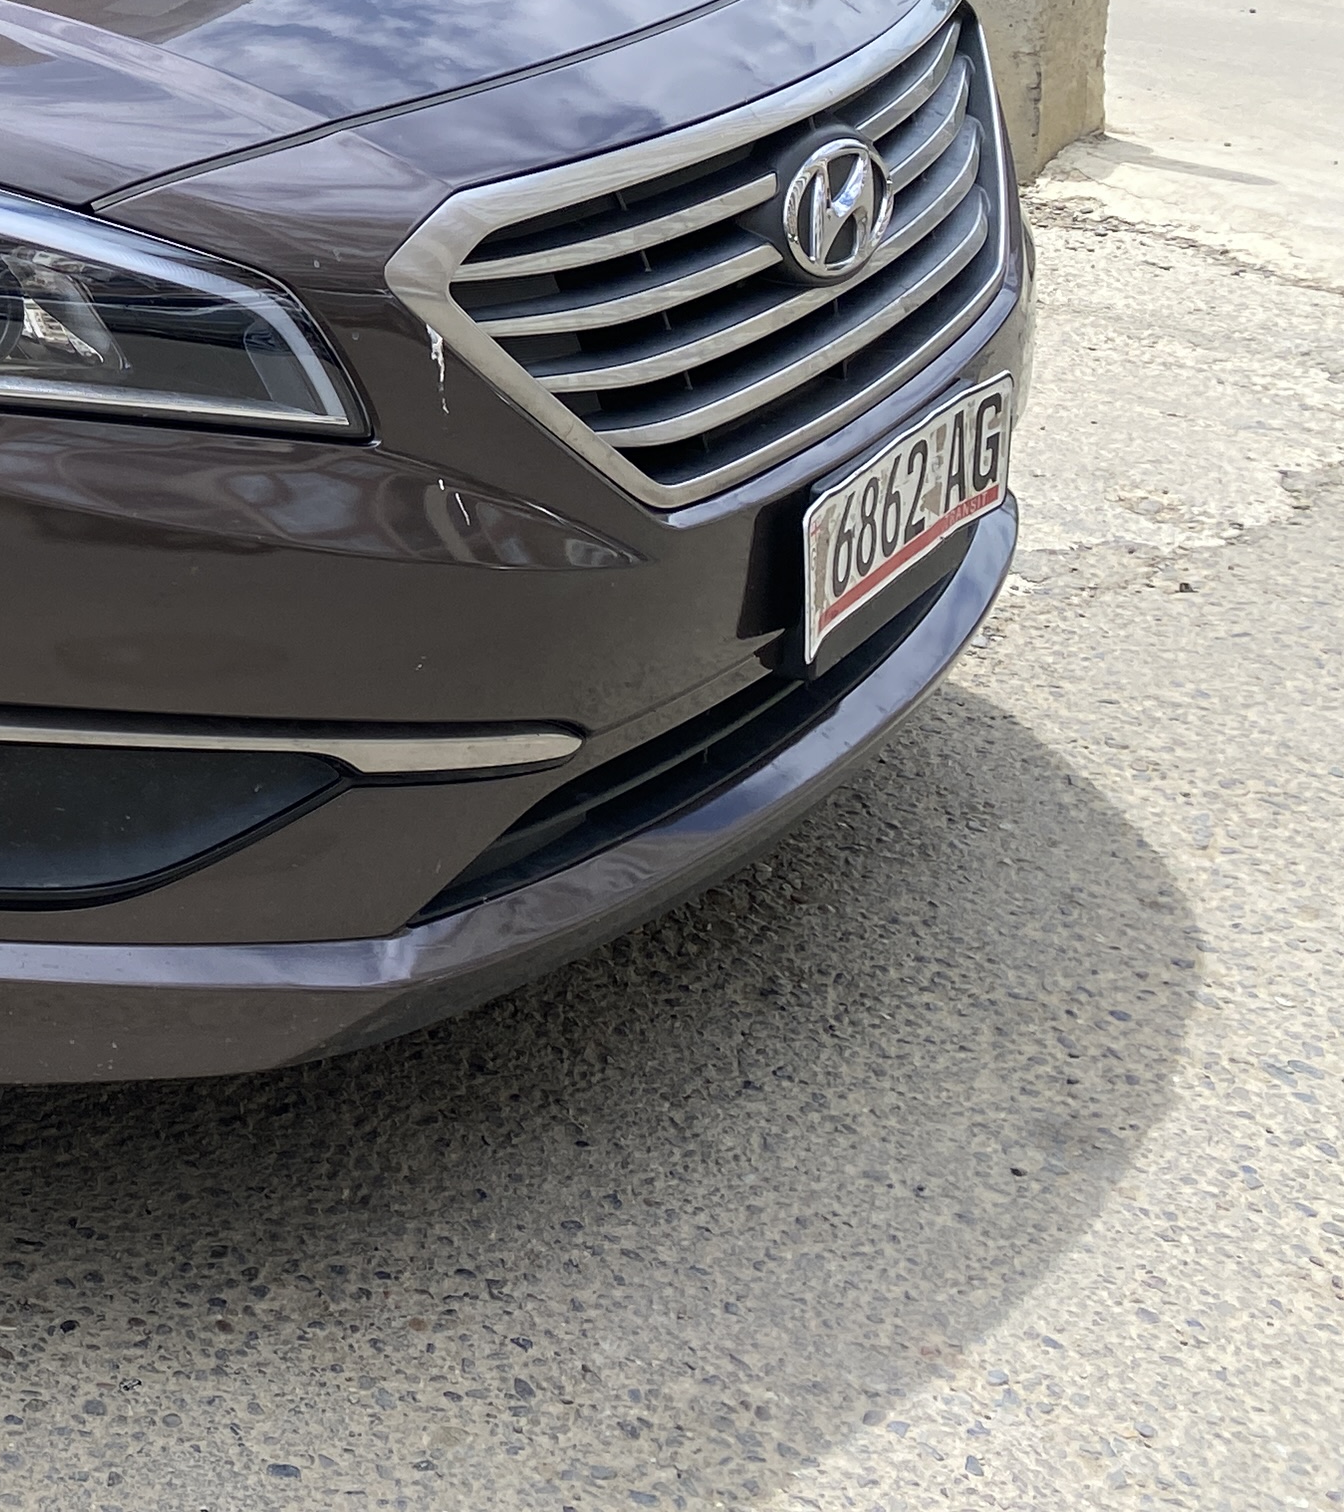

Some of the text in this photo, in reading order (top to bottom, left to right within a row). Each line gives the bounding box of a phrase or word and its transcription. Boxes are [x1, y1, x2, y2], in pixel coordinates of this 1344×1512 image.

[833, 392, 1003, 598] 6862 AG
[944, 491, 989, 530] TRANSIT
